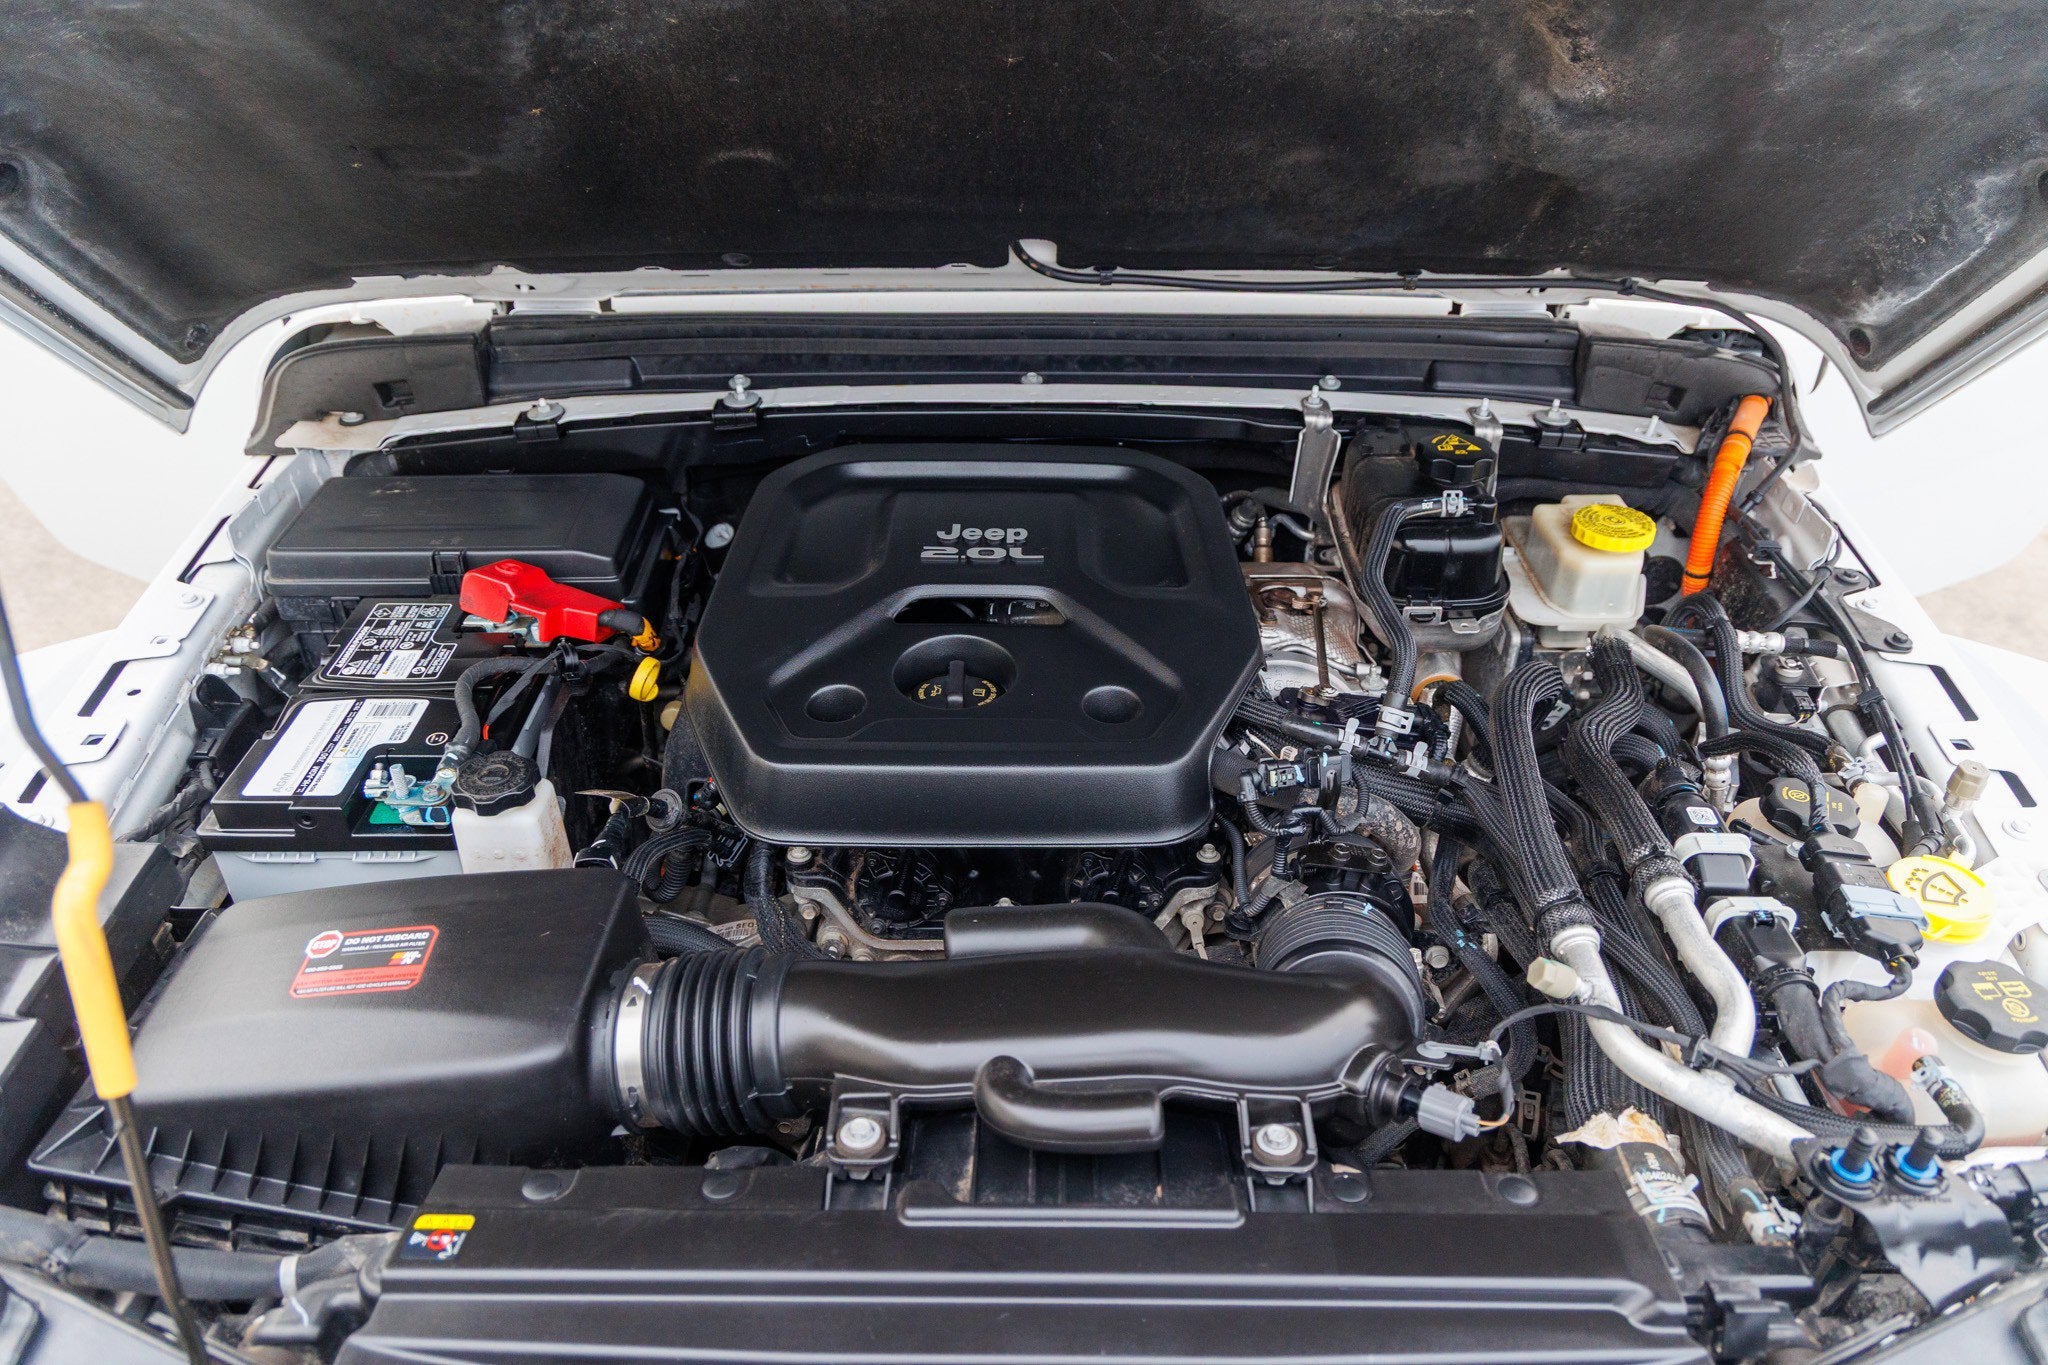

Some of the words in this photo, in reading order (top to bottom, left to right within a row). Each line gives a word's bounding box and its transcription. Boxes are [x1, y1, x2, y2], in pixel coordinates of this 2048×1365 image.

[936, 524, 1028, 544] Jeep
[920, 546, 1044, 562] 2.0L
[272, 772, 294, 793] AGM
[311, 938, 337, 950] STOP
[383, 932, 430, 942] DISCARD
